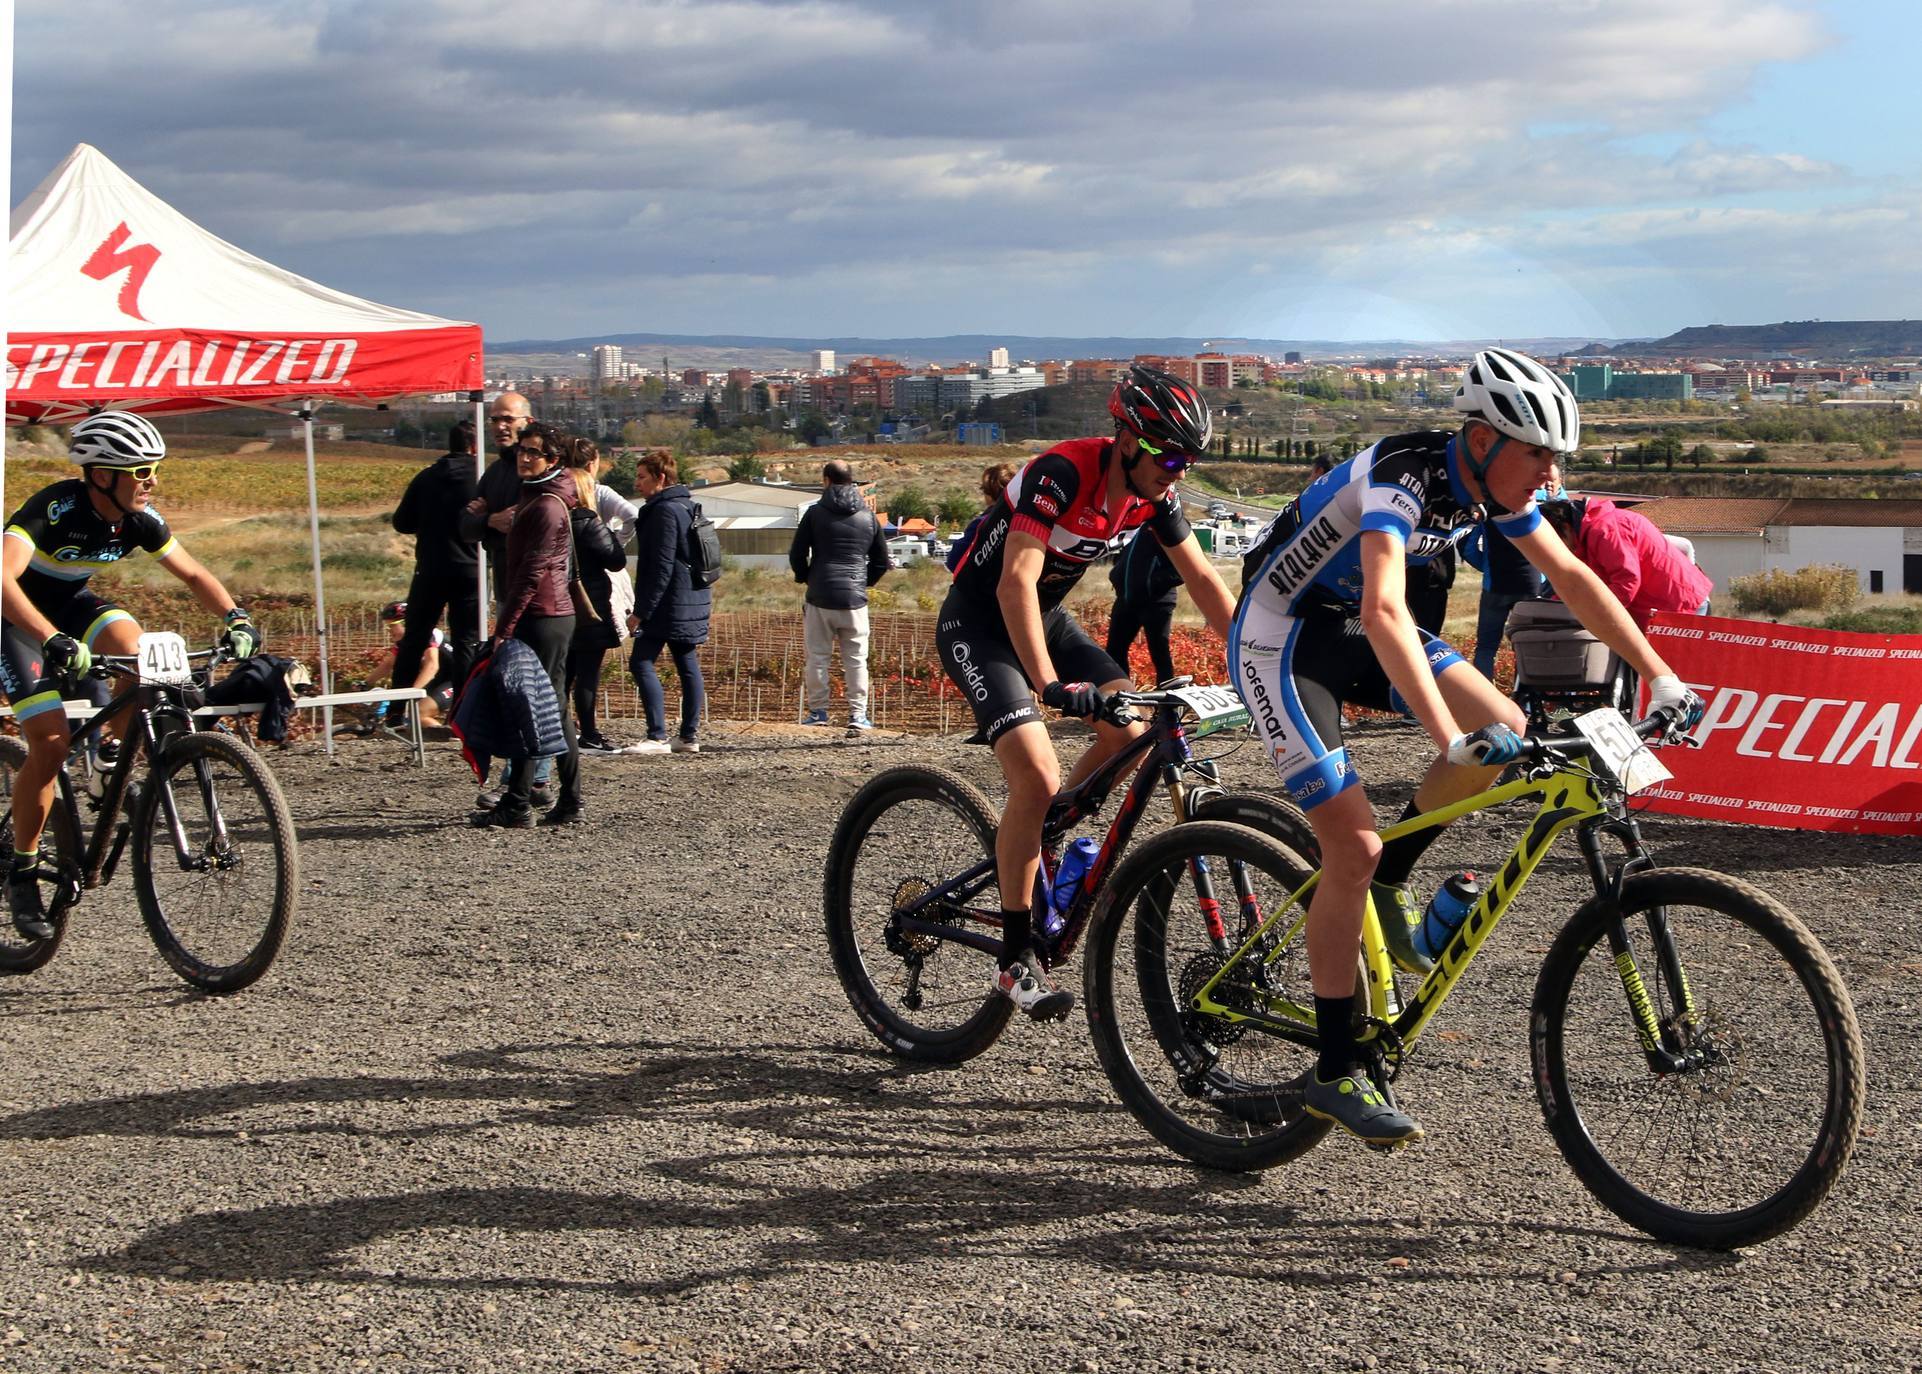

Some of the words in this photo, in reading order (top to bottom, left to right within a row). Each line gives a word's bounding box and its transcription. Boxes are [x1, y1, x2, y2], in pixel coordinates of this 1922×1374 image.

[974, 518, 1008, 567] COLOMA
[1268, 516, 1343, 595] ATALAYA
[146, 641, 182, 673] 413
[1646, 625, 1703, 639] SPECIALIZED
[1706, 631, 1766, 647] SPECIALIZED
[1769, 638, 1828, 655] SPECIALIZED
[1831, 646, 1886, 658] SPECIALIZED
[1686, 792, 1743, 808] SPECIALIZED
[1745, 800, 1801, 814] SPECIALIZED
[1803, 806, 1859, 819] SPECIALIZED
[1861, 811, 1912, 822] SPECIALIZED
